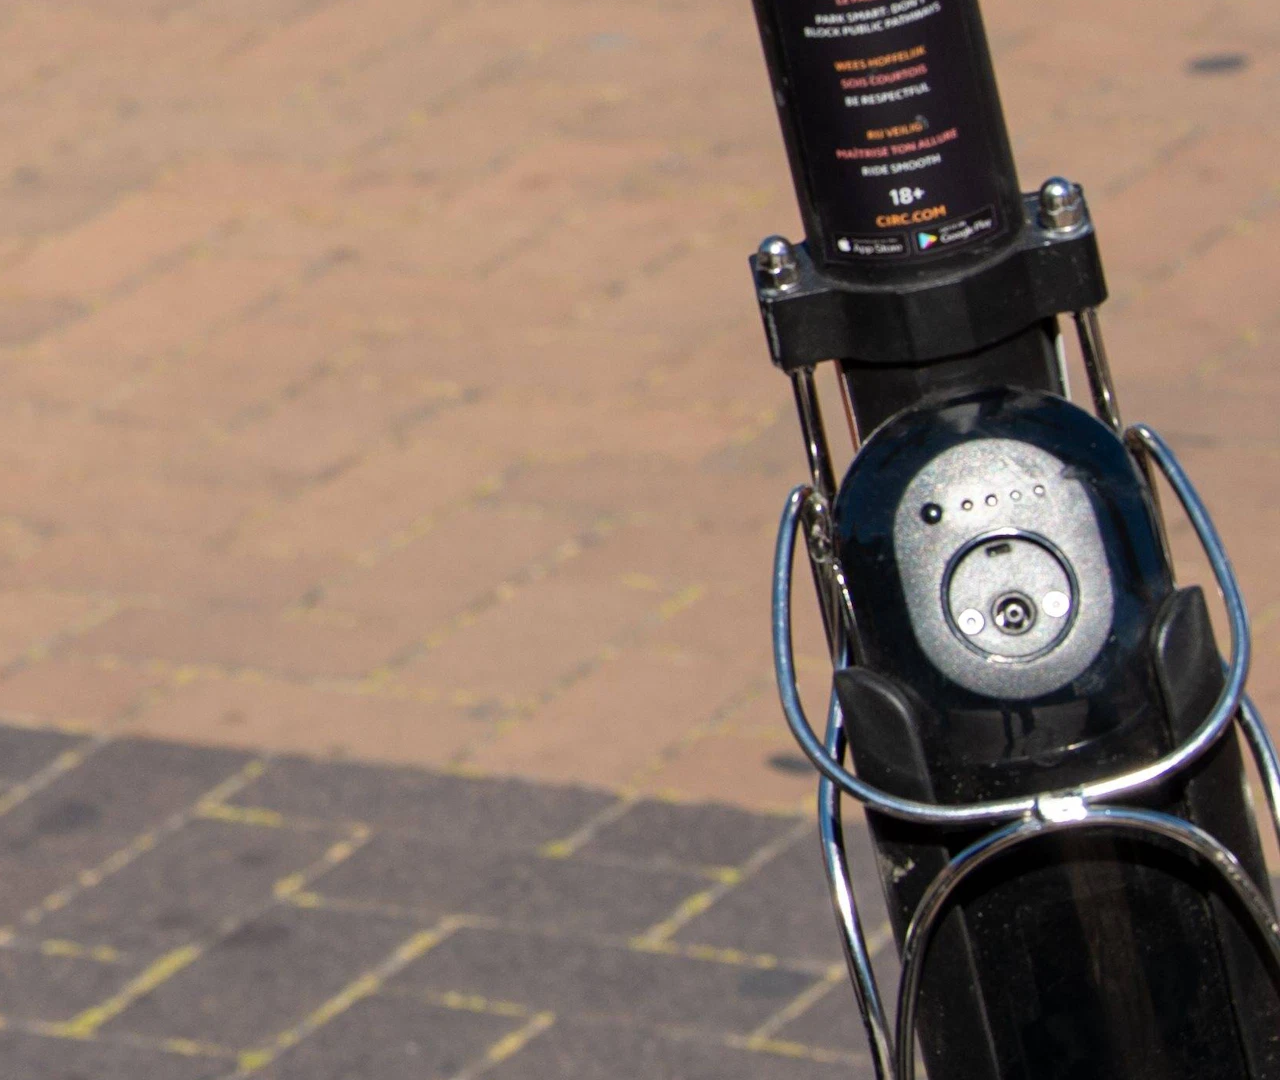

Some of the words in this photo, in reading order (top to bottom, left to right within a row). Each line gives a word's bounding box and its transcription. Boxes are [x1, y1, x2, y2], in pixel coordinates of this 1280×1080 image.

[844, 95, 859, 107] BE
[860, 82, 931, 105] RESPECTFUL
[861, 164, 889, 176] RIDE
[890, 153, 942, 174] SMOOTH
[889, 187, 925, 206] 18+
[876, 204, 947, 228] CIRC.COM
